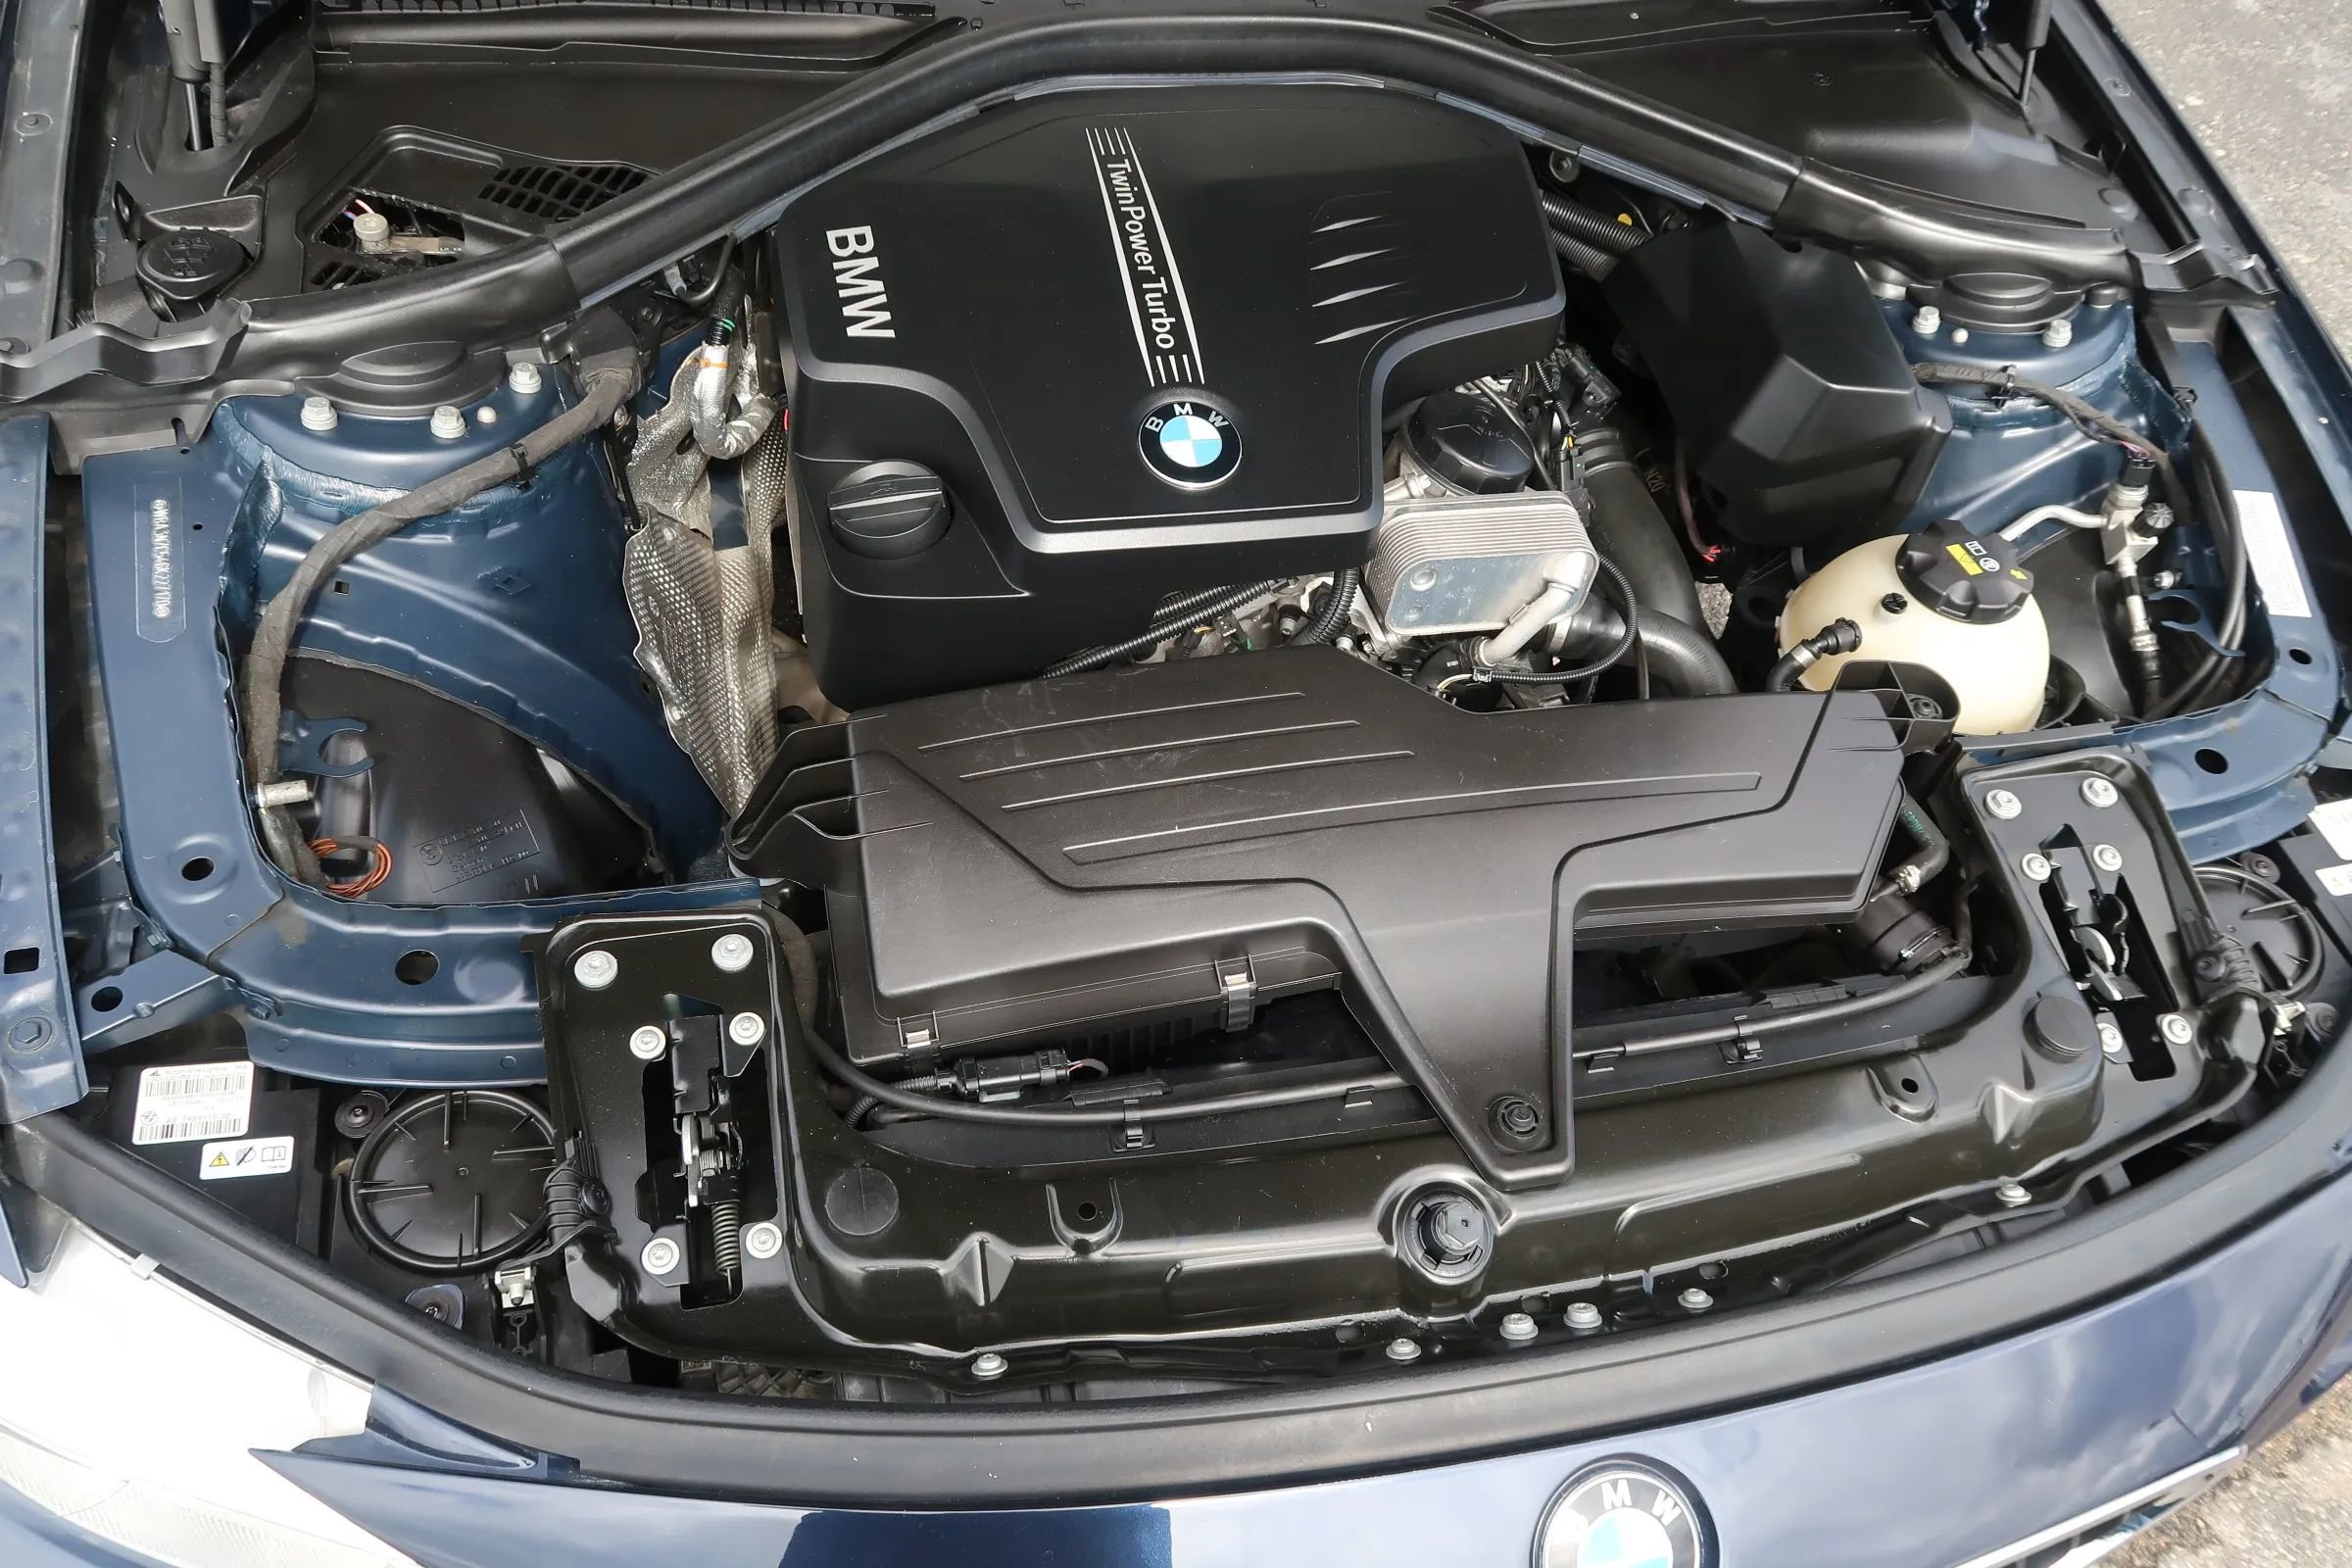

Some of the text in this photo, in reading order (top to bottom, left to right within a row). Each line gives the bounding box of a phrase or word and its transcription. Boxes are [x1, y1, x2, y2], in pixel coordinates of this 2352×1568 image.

[825, 224, 896, 338] BMW
[1106, 158, 1176, 350] TwinPower Turbo
[1145, 402, 1230, 433] BMW
